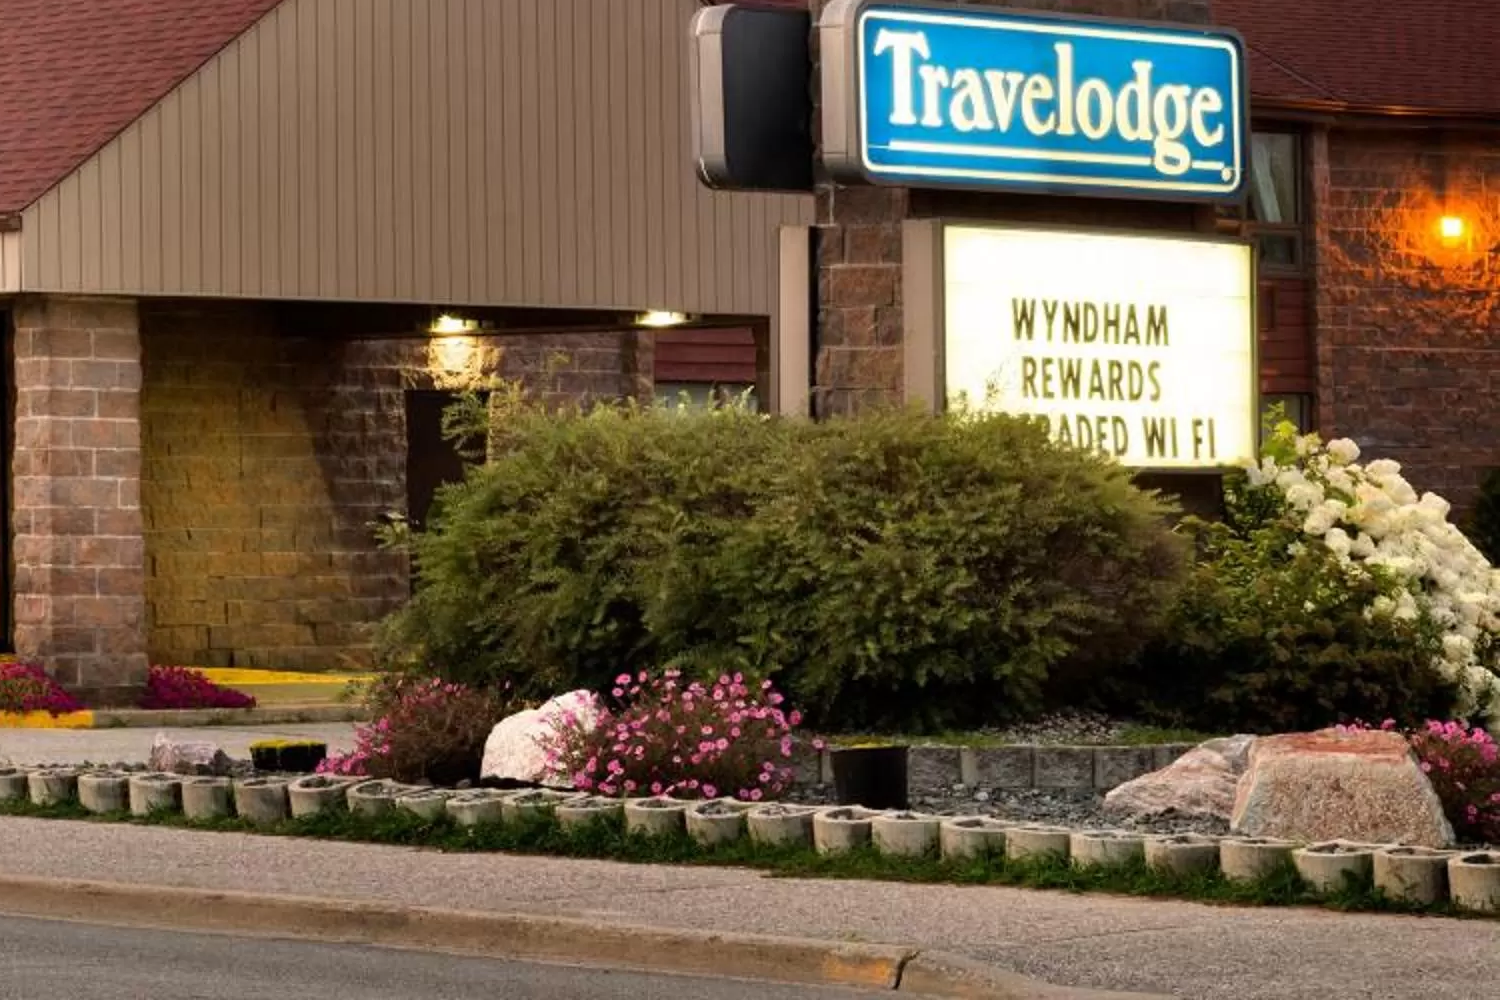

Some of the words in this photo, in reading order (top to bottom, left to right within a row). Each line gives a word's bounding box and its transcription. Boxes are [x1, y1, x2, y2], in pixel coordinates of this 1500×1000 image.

[874, 29, 1224, 174] Travelodge
[1011, 298, 1169, 346] WYNDHAM
[1021, 356, 1161, 401] REWARDS
[1142, 417, 1178, 458] WI
[1191, 418, 1215, 460] FI
